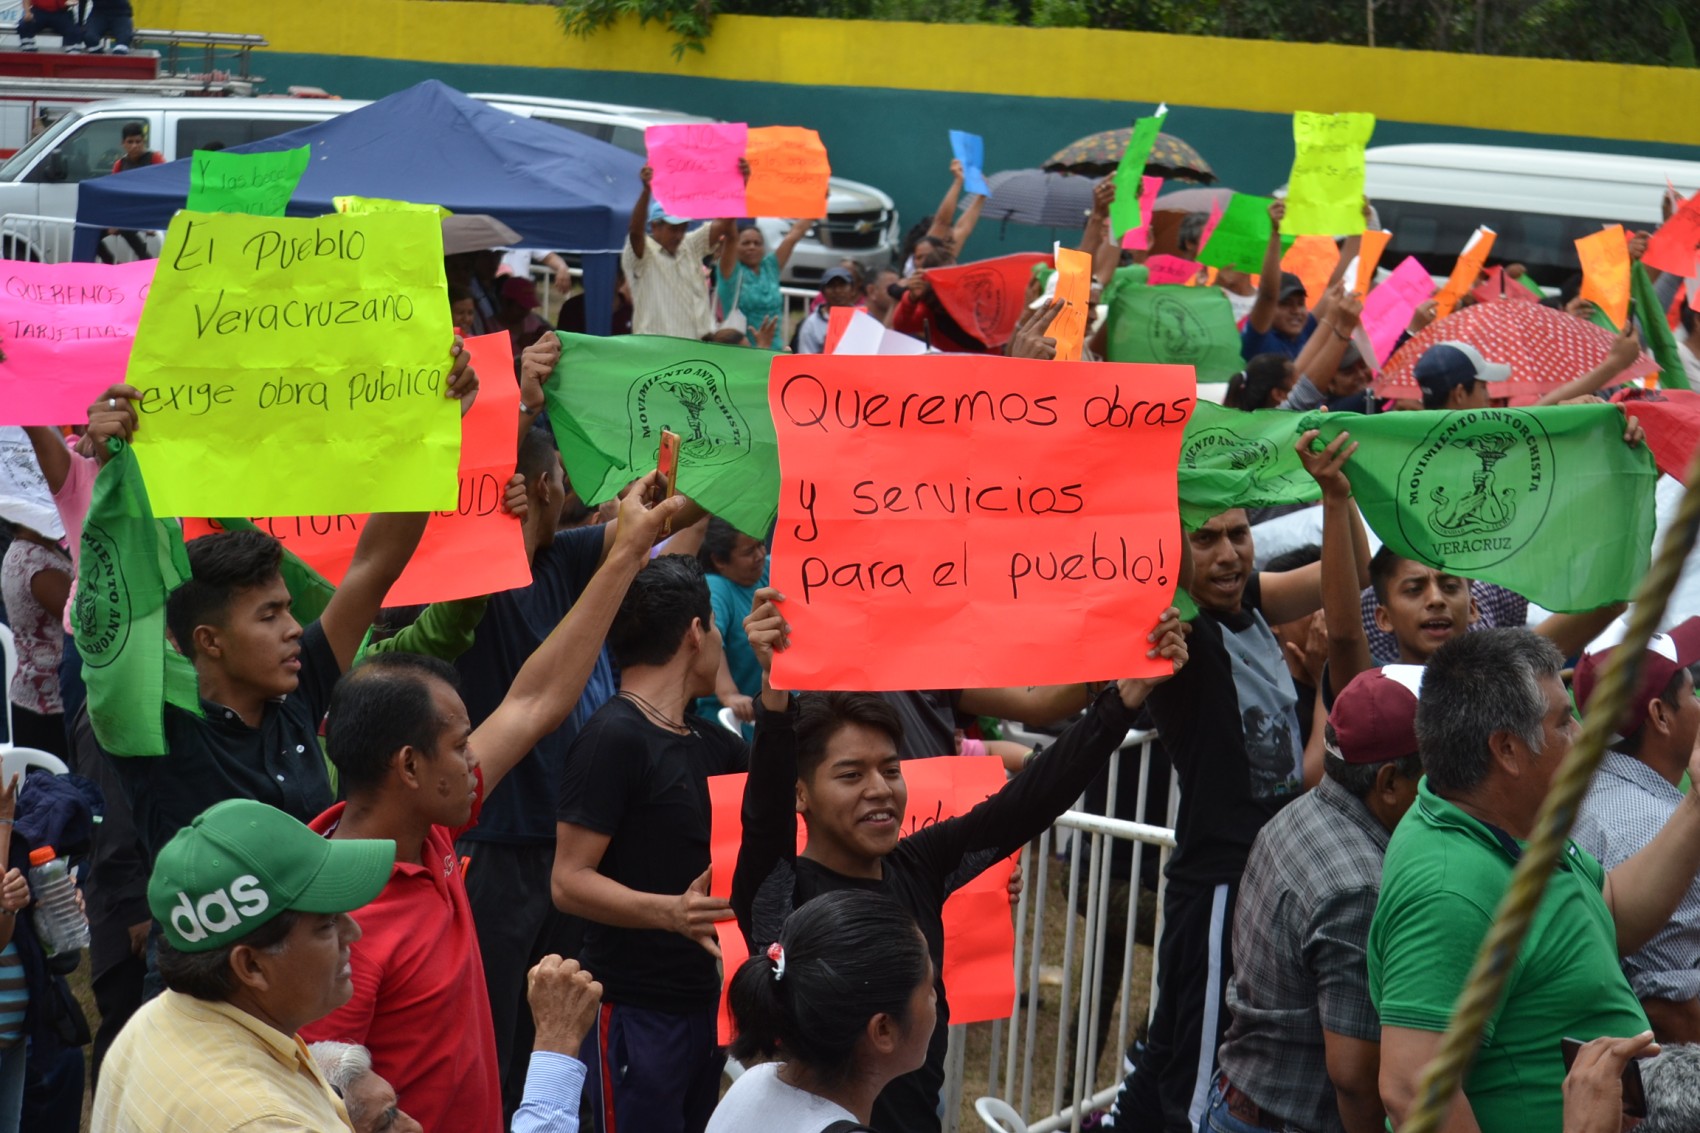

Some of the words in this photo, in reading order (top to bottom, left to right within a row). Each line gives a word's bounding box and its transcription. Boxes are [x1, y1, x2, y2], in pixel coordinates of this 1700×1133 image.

[173, 220, 214, 272] El
[242, 227, 365, 271] Pueblo
[6, 275, 126, 305] QUEREMOS
[194, 289, 414, 339] Veracruzano
[139, 380, 237, 416] exige
[259, 376, 328, 412] obra
[637, 367, 693, 440] MOVIMIENTO
[691, 368, 742, 447] ANTORCHISTA
[781, 374, 1059, 433] Queremos
[1084, 385, 1191, 428] obras
[1409, 412, 1478, 506] MOVIMIENTO
[1480, 410, 1542, 493] ANTORCHISTA
[793, 479, 818, 542] y
[853, 476, 1084, 515] servicios
[801, 556, 912, 605] para
[932, 540, 969, 588] el
[1009, 532, 1168, 600] pueblo!
[1431, 537, 1512, 556] VERACRUZ
[170, 874, 270, 943] das
